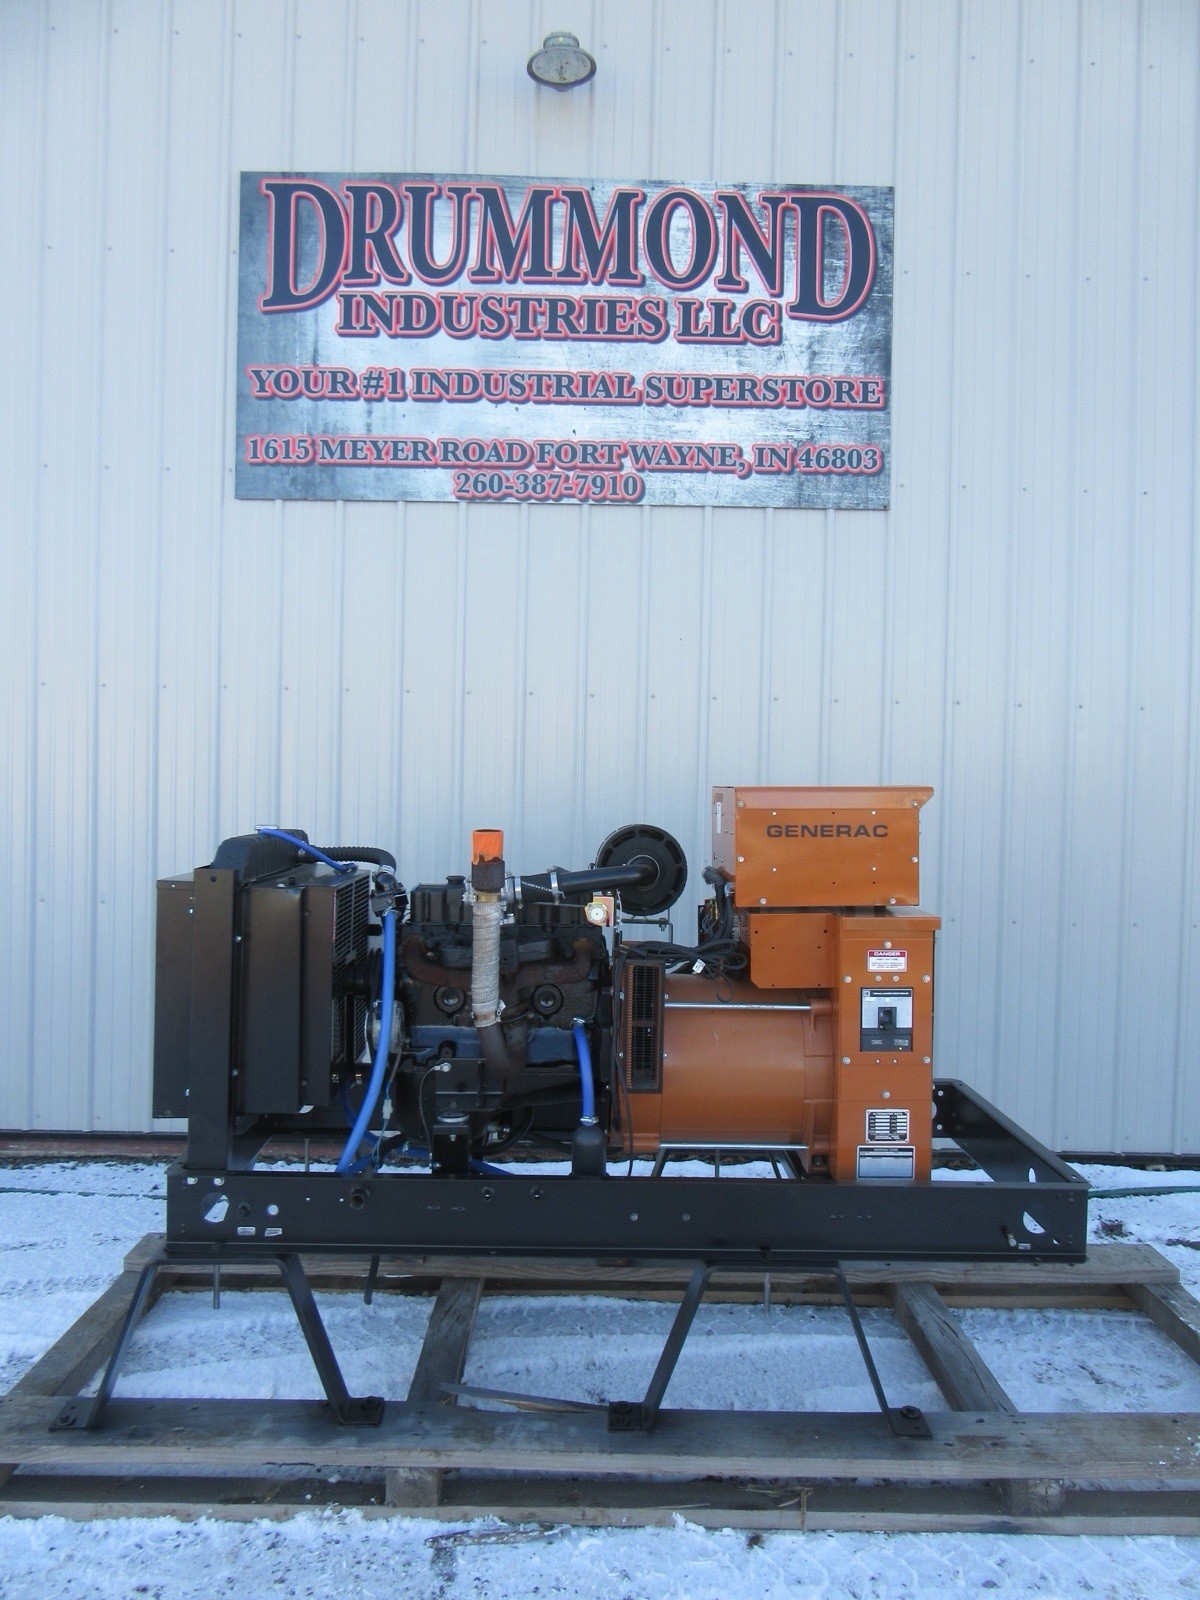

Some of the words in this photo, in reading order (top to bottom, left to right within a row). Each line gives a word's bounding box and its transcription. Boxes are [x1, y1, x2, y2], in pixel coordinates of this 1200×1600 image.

[260, 181, 874, 318] DRUMMOND
[336, 292, 666, 338] INDUSTRIES
[676, 299, 778, 340] LLC
[250, 368, 356, 395] YOUR
[362, 369, 403, 395] #1
[412, 371, 637, 399] INDUSTRIAL
[644, 375, 882, 404] SUPERSTORE
[248, 437, 312, 460] 1615
[318, 438, 433, 463] MEYER
[440, 440, 529, 464] ROAD
[536, 442, 622, 467] FORT
[628, 443, 747, 473] WAYNE,
[754, 446, 793, 469] IN
[799, 448, 879, 471] 46803
[455, 472, 640, 496] 260-387-7910
[766, 824, 889, 838] GENERAC
